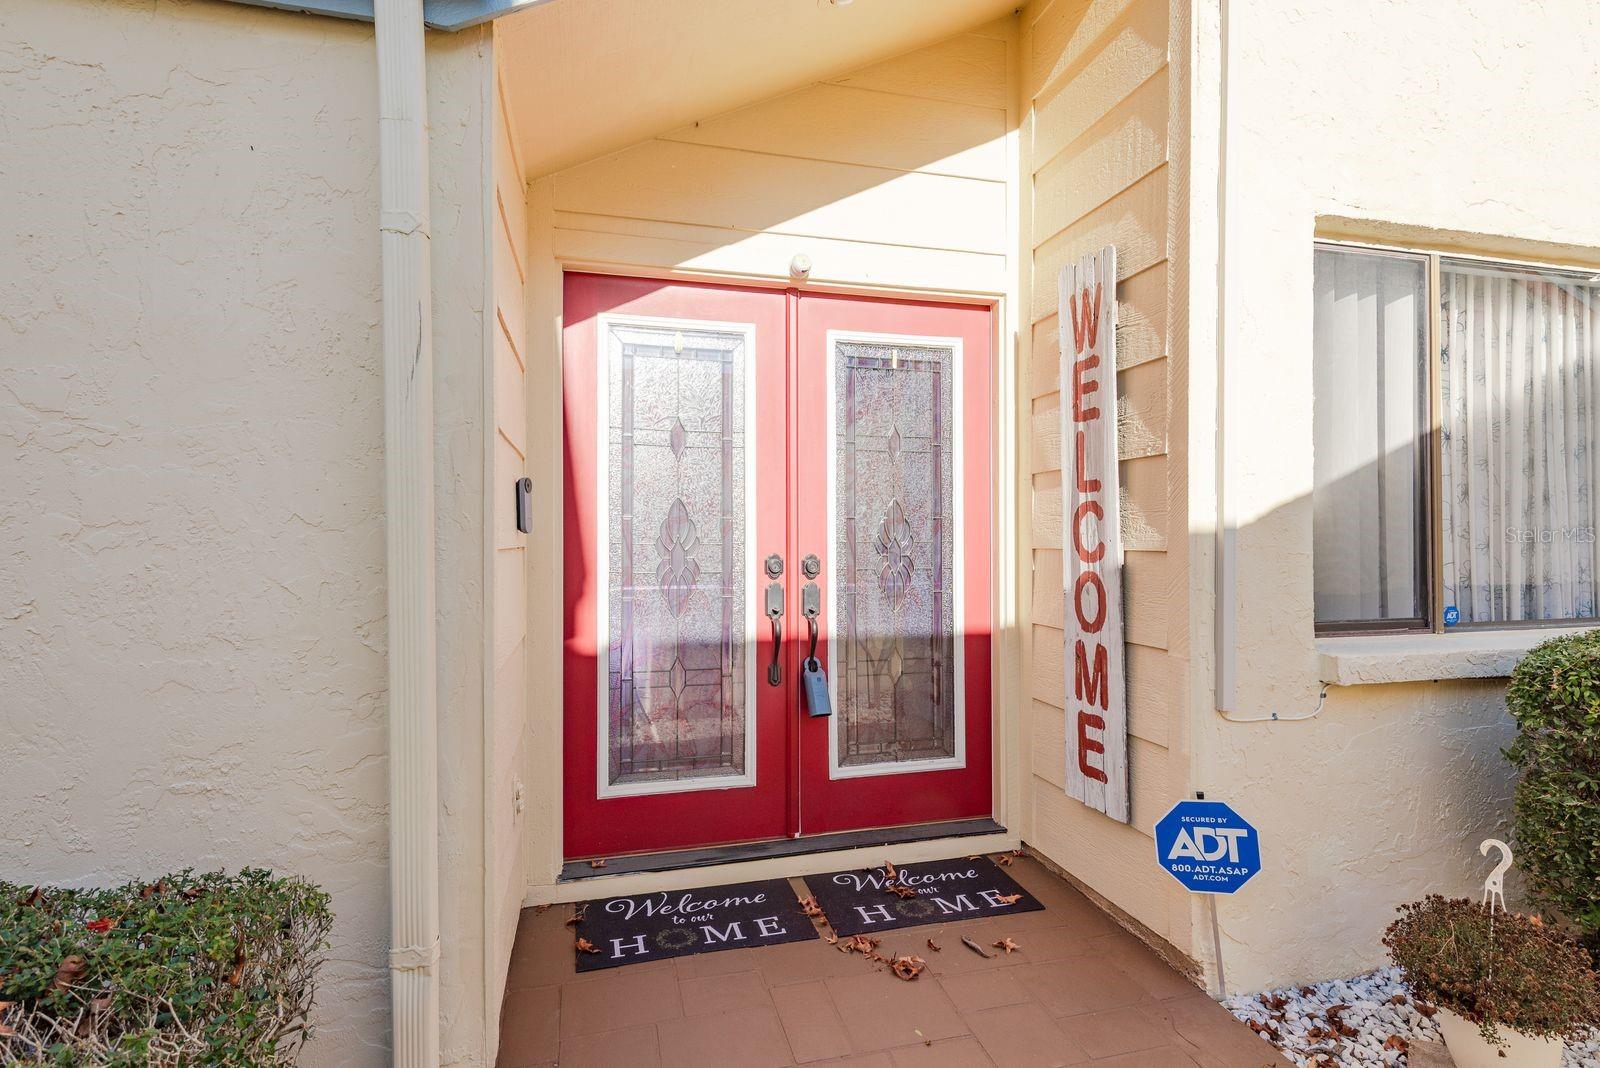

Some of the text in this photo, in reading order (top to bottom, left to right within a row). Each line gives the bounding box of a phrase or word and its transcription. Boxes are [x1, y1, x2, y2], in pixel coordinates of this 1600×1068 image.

[1070, 281, 1109, 786] WELCOME
[1167, 826, 1249, 863] ADT
[1171, 863, 1249, 876] 800.ADT.ASAP
[1192, 874, 1229, 882] ADT.COM
[832, 868, 979, 892] Welcome
[917, 886, 940, 895] our
[605, 892, 767, 920] Welcome
[671, 913, 715, 925] to our
